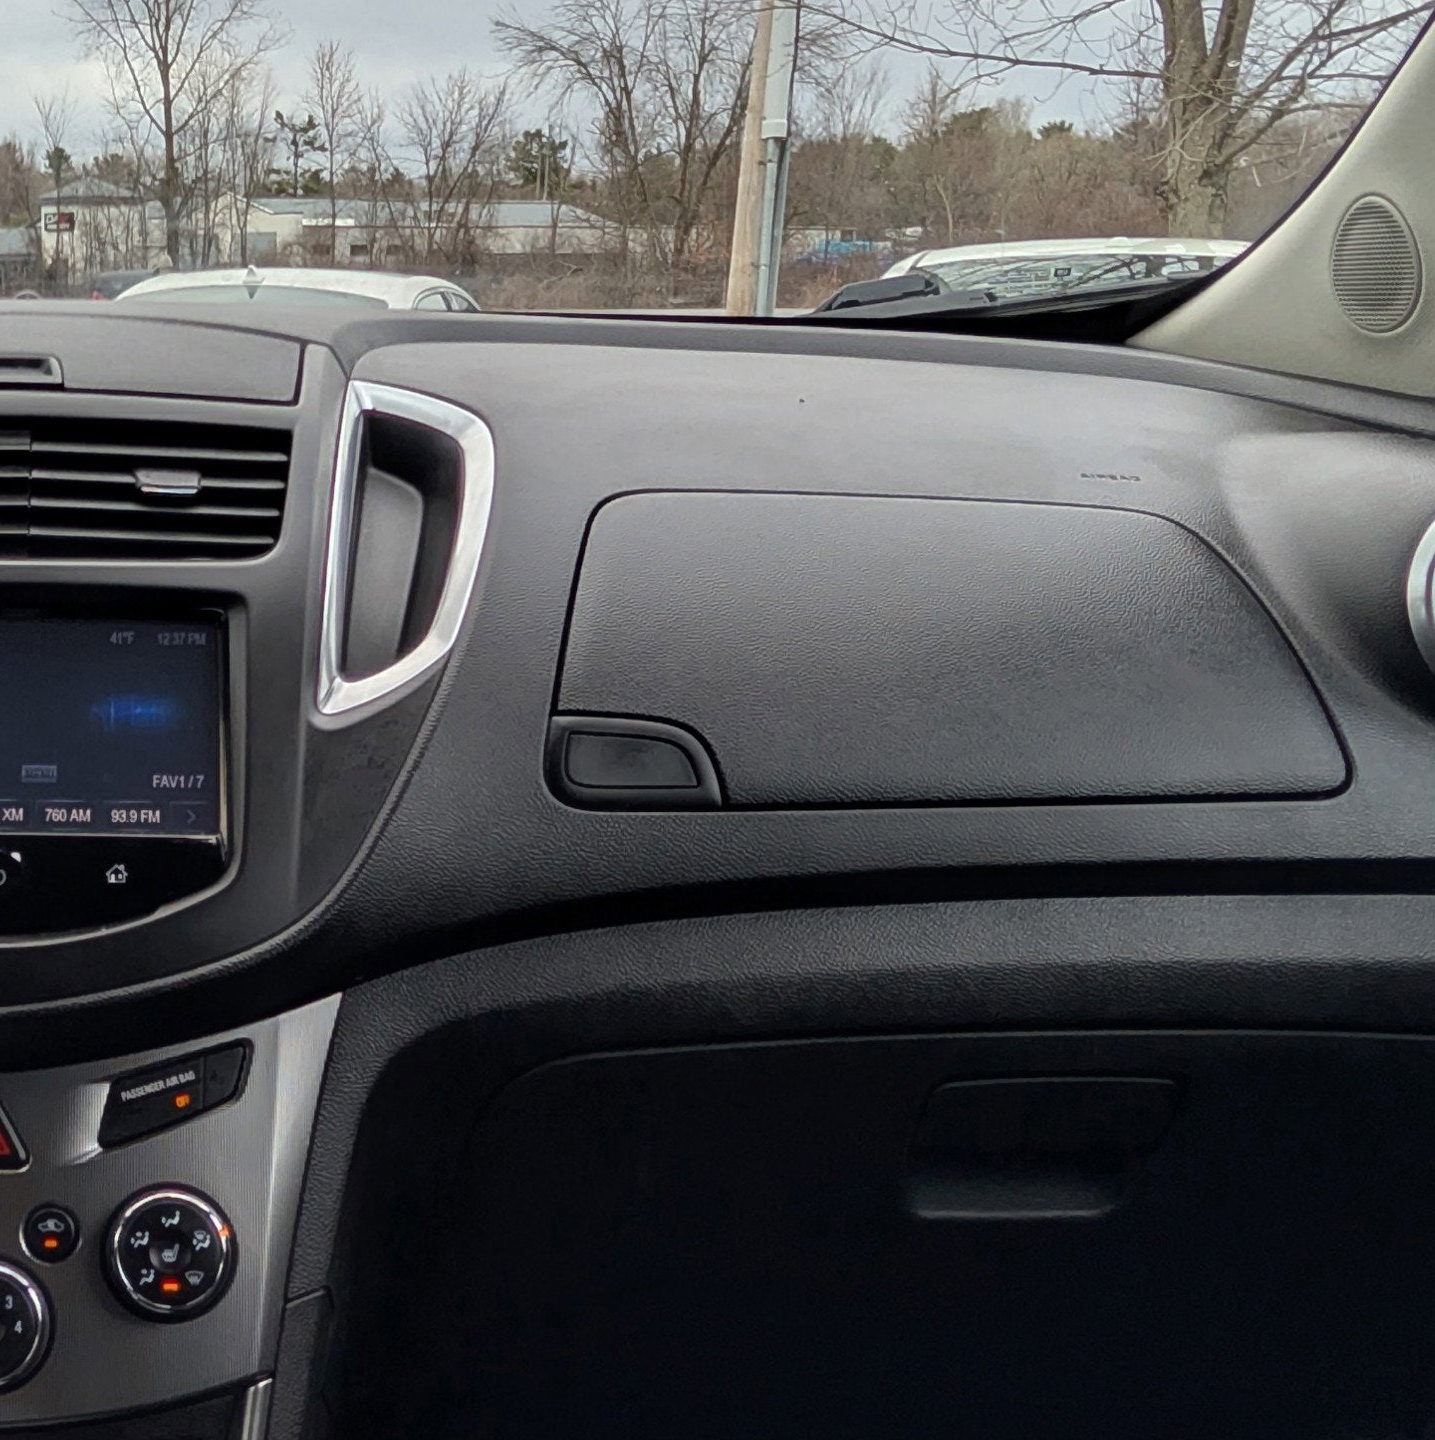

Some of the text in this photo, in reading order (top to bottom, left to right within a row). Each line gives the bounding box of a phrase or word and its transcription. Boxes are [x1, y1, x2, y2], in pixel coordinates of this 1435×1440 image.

[152, 774, 185, 789] FAV1
[2, 808, 25, 822] XM
[44, 808, 92, 823] 760 AM
[111, 809, 162, 824] 93.9 FM
[120, 1079, 166, 1103] PASSENGER
[5, 1295, 14, 1310] 3
[14, 1320, 23, 1334] 4
